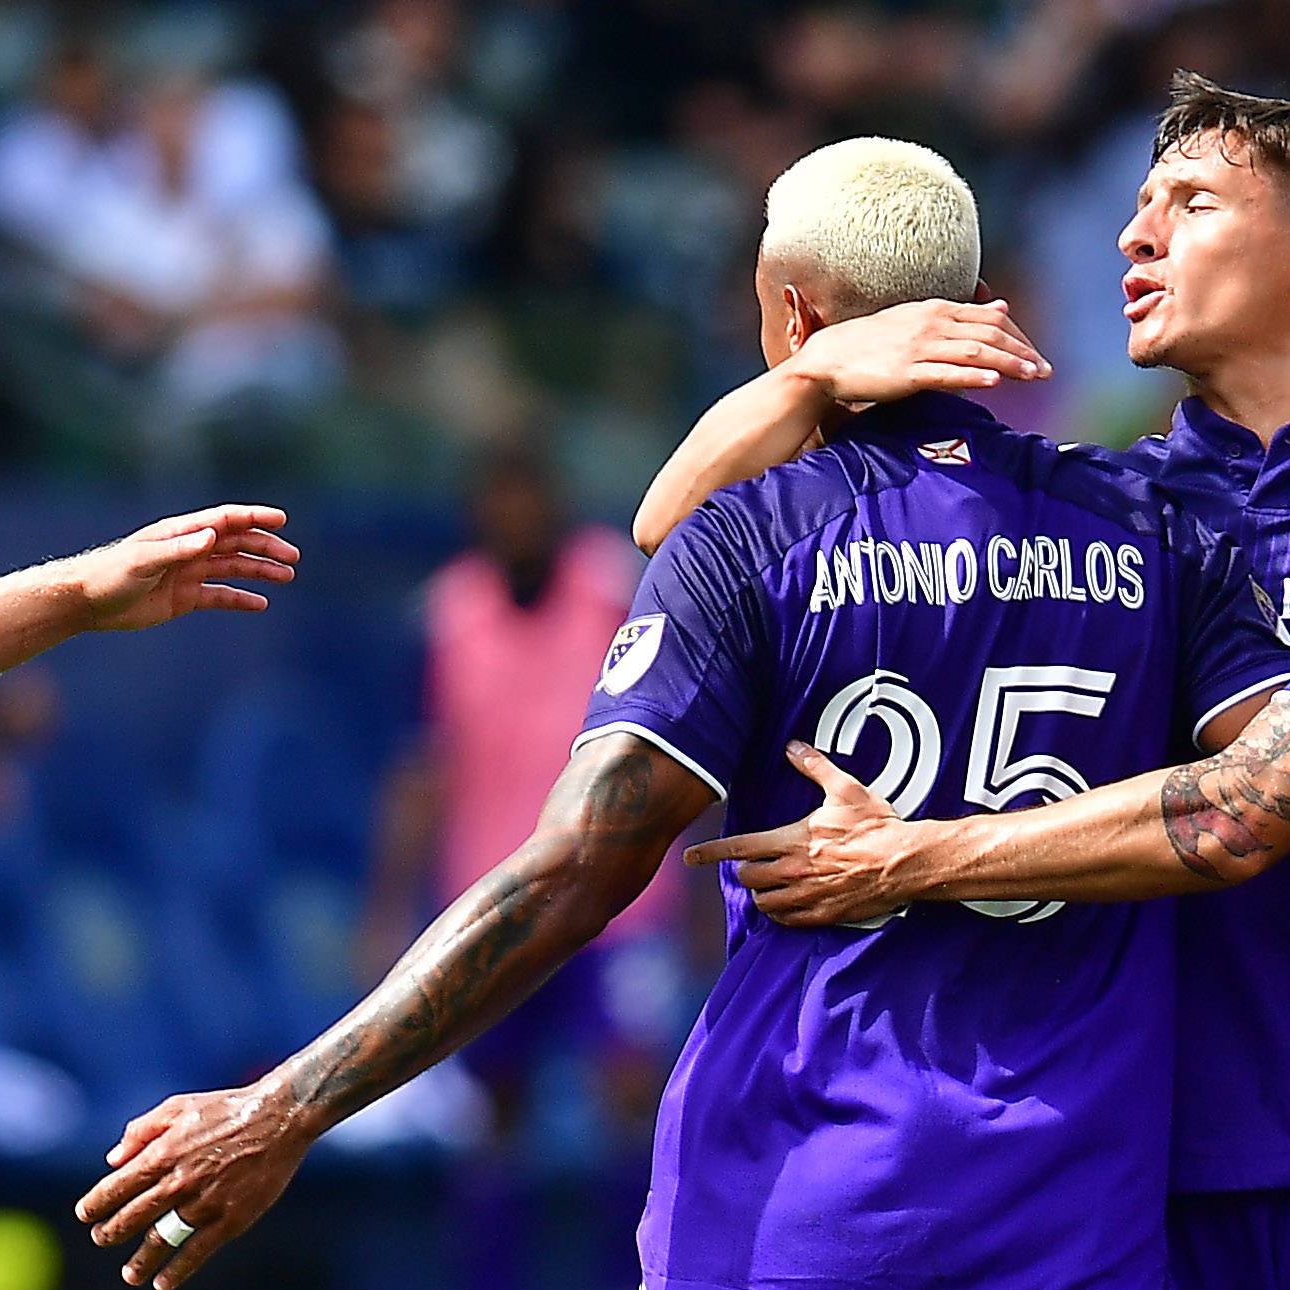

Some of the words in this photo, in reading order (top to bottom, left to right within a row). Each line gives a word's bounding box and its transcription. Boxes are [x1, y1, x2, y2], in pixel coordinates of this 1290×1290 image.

[810, 536, 978, 613] ANTONIO
[987, 534, 1144, 610] CARLOS
[814, 666, 1115, 929] 25
